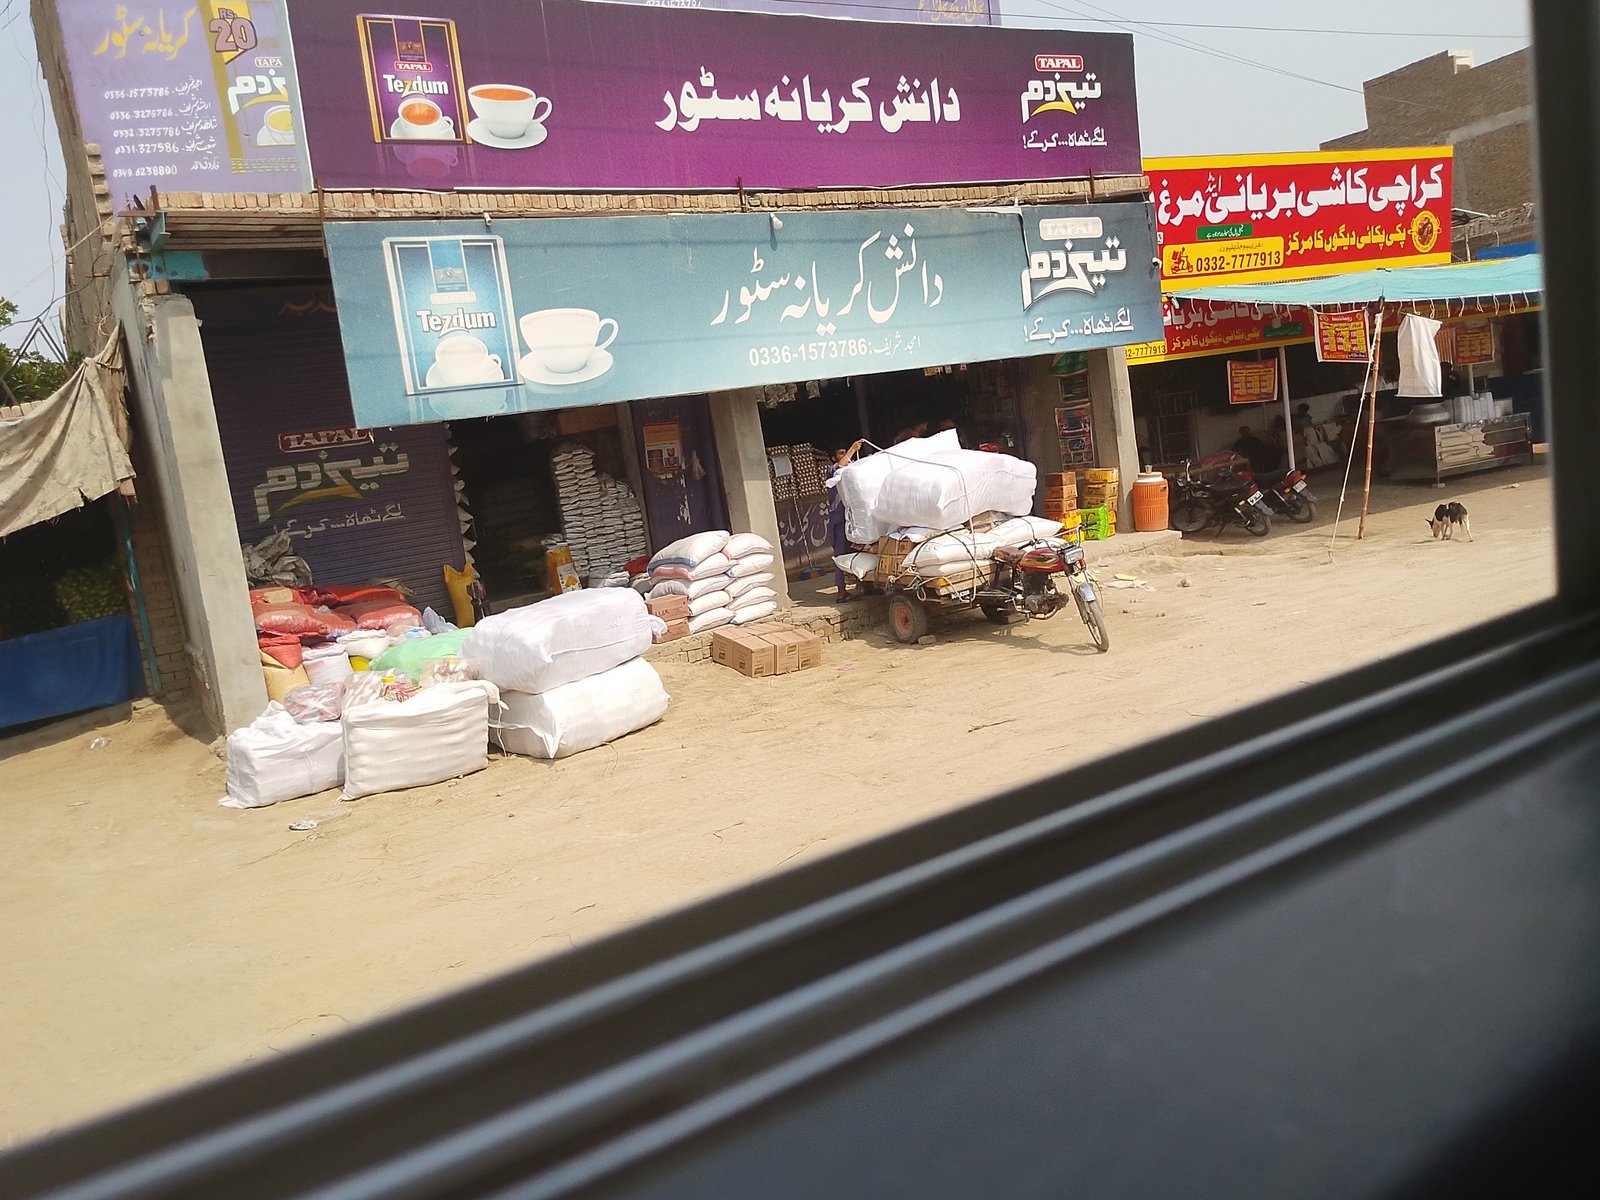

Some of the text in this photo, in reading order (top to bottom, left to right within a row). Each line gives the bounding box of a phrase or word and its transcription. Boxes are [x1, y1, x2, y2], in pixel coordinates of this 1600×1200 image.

[209, 17, 257, 53] 20
[256, 58, 283, 67] TAPA
[396, 63, 431, 71] TAPAL
[1037, 57, 1082, 69] TAPAL
[383, 74, 449, 99] Tezdum
[655, 66, 962, 134] دانش کریانہ سٹور
[1157, 178, 1206, 226] مرغ
[1203, 172, 1296, 224] بریانی
[1296, 166, 1369, 218] کاشی
[1368, 163, 1444, 217] کراچی
[1285, 223, 1407, 256] پکی پکائی دیگوں کا مرکز
[1196, 250, 1281, 273] 0332-7777913
[710, 223, 944, 337] دانش کریانہ سٹور
[416, 308, 497, 338] Tezdum
[749, 338, 868, 367] 0336-1573786
[904, 335, 921, 355] امجد
[284, 427, 368, 449] TAPAL
